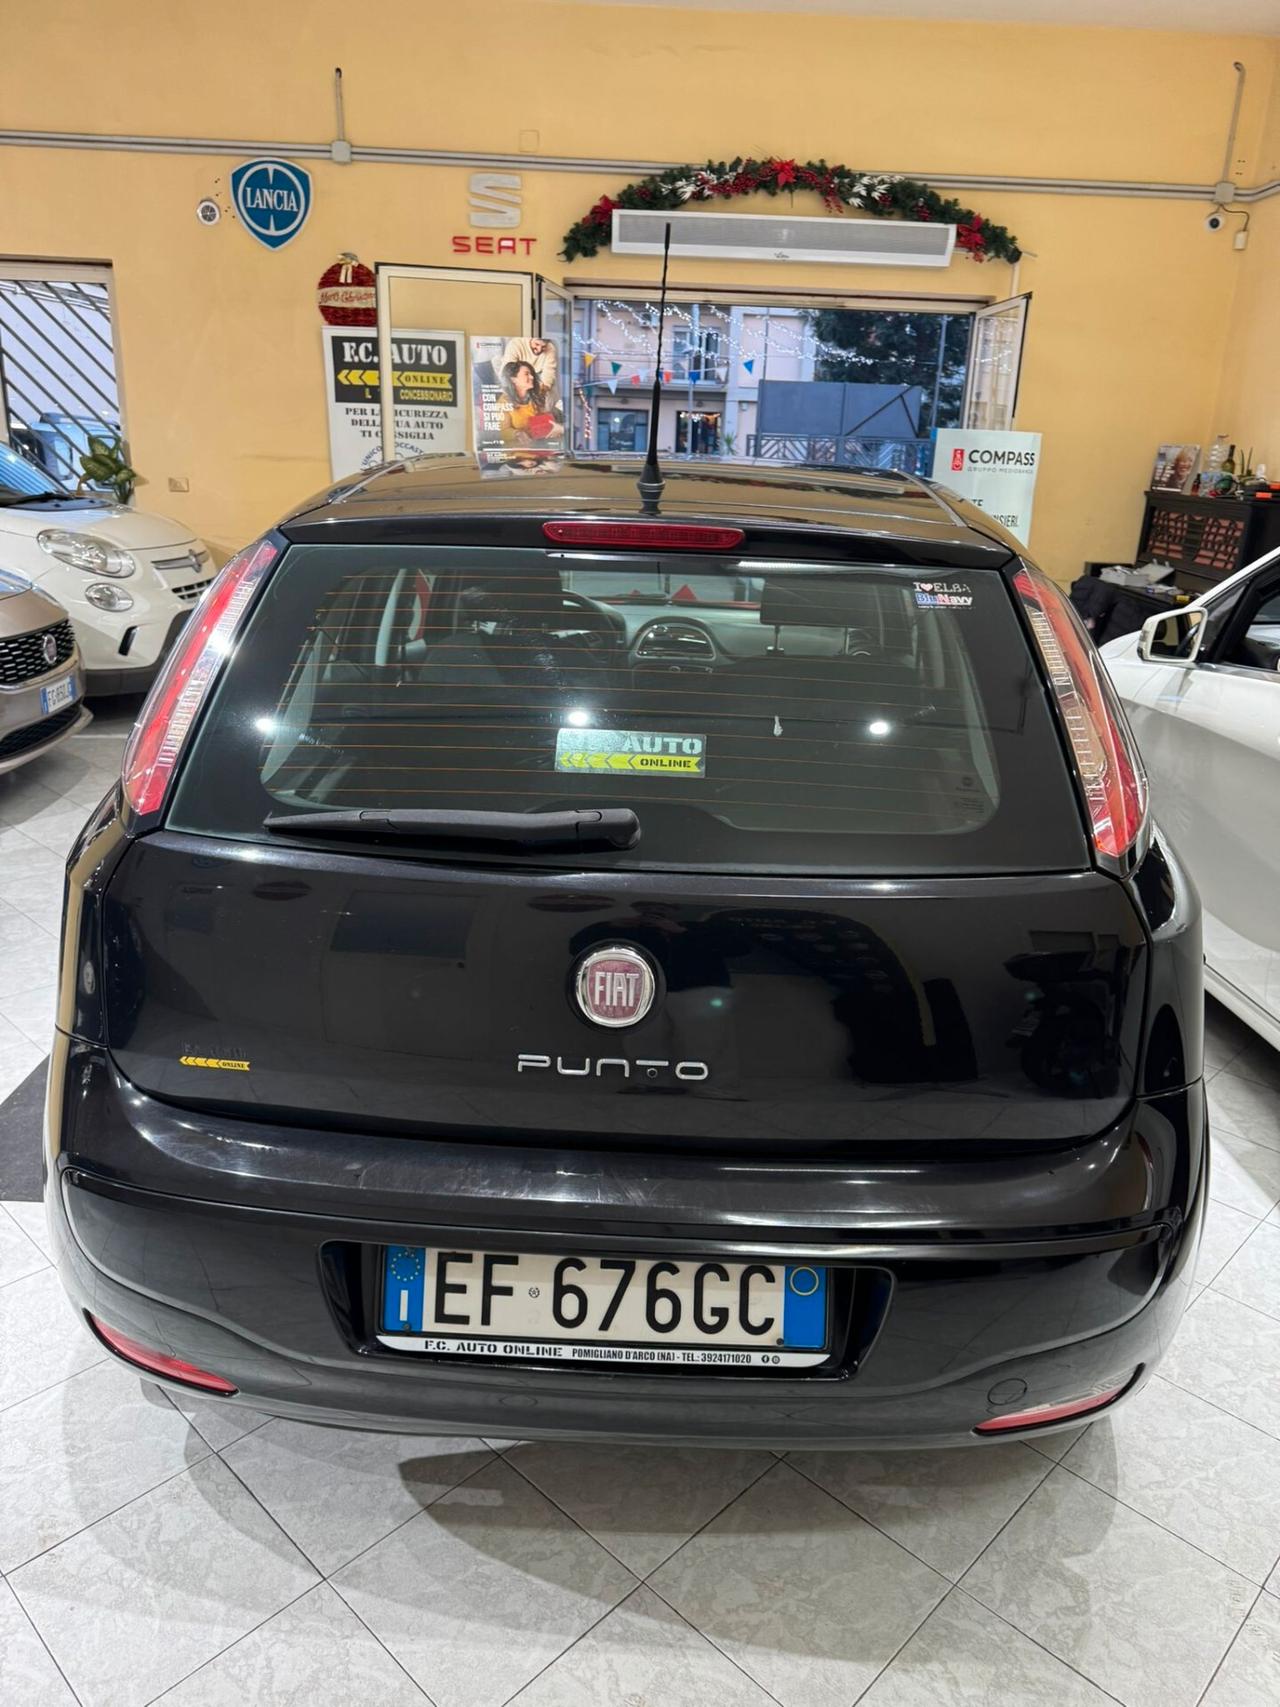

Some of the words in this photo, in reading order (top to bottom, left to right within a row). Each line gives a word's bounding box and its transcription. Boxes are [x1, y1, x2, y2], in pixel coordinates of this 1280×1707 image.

[245, 187, 299, 212] LANCIA
[452, 236, 537, 255] SEAT
[342, 341, 379, 363] F.C.
[391, 343, 448, 366] AUTO
[404, 375, 446, 385] ONLINE
[482, 393, 497, 402] CON
[345, 407, 368, 416] PER
[393, 409, 449, 419] ICUREZZA
[483, 403, 514, 412] COMPASS
[484, 412, 491, 421] SI
[351, 418, 381, 428] DELL
[395, 420, 413, 429] UA
[413, 421, 444, 430] AUTO
[484, 421, 501, 431] FARE
[360, 430, 372, 438] TI
[968, 449, 1035, 466] COMPASS
[913, 582, 922, 592] I
[933, 582, 972, 593] ELBA
[621, 734, 702, 755] AUTO
[639, 758, 692, 768] ONLINE
[594, 971, 640, 1007] FIAT
[517, 1054, 709, 1081] PUNTO
[434, 1252, 520, 1326] EF
[552, 1257, 777, 1337] 676GC
[424, 1340, 450, 1351] F.C.
[456, 1342, 498, 1354] AUTO
[503, 1344, 563, 1357] ONLINE
[572, 1349, 623, 1360] POMIGLIANO
[625, 1350, 656, 1361] D'ARCO
[700, 1353, 752, 1364] 3924171020
